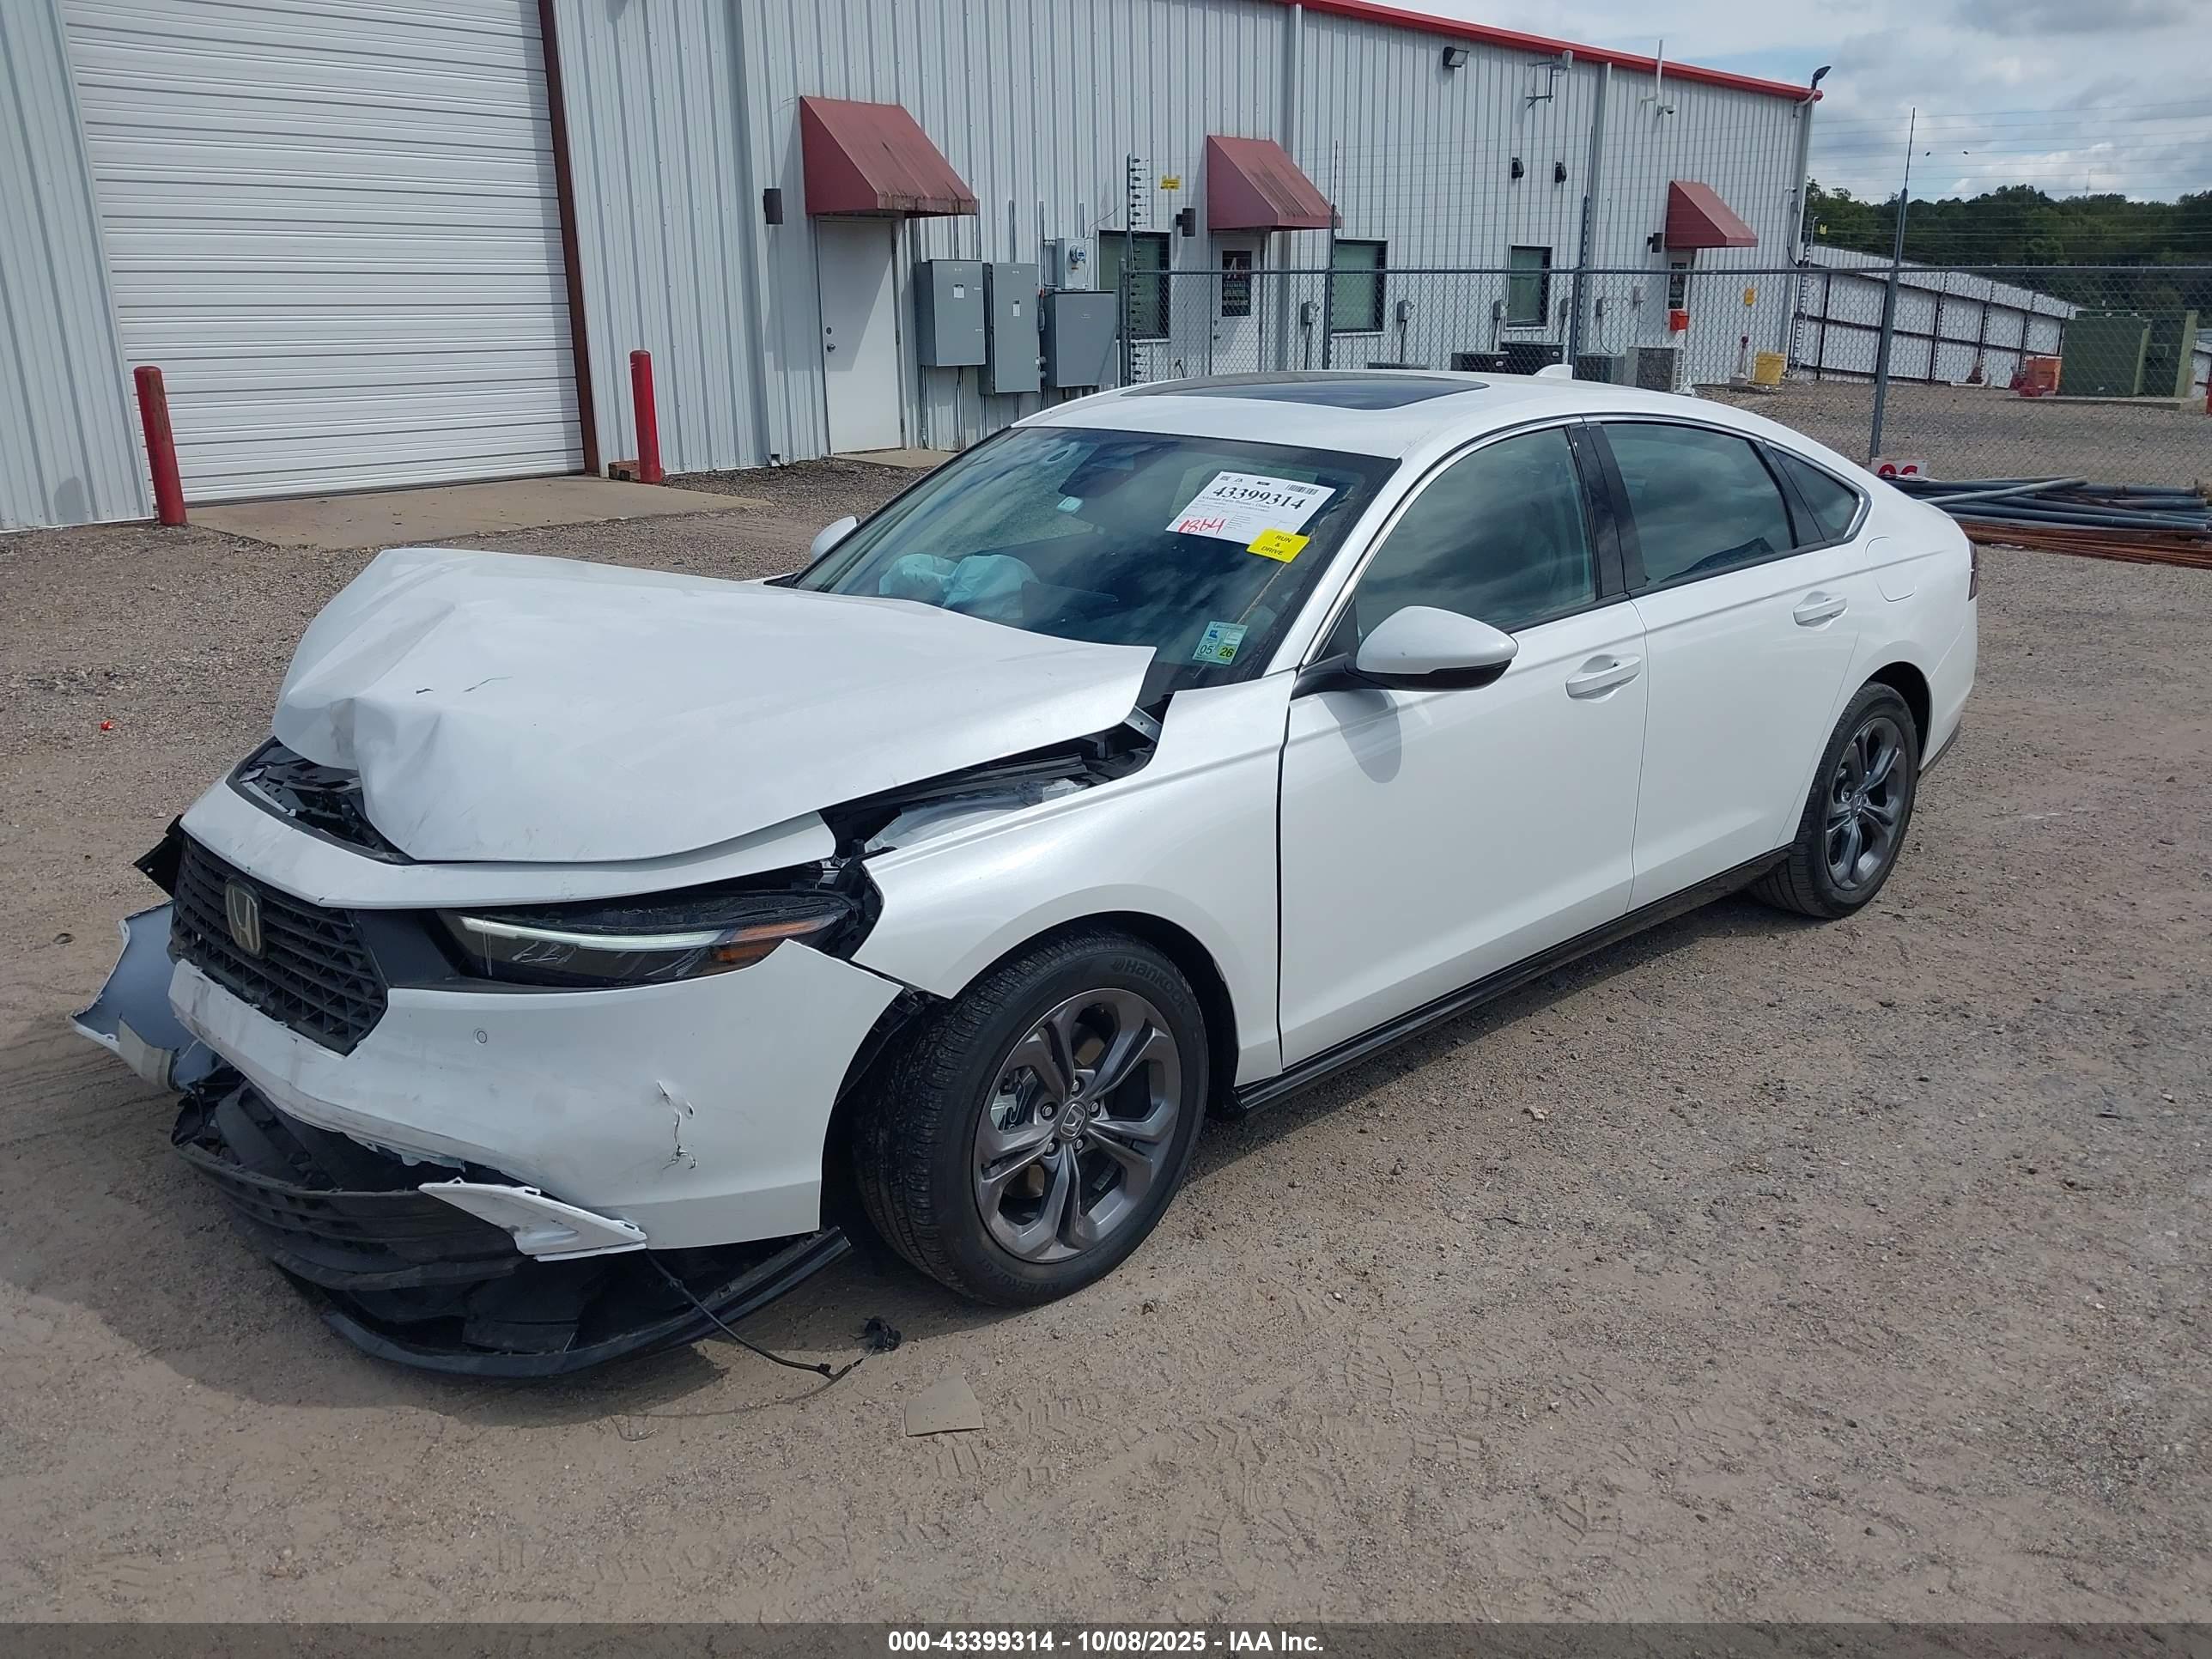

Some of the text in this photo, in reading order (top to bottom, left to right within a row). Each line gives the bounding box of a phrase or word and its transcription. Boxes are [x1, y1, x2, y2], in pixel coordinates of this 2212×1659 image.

[1212, 486, 1307, 510] 43399314
[1274, 534, 1292, 543] RUN
[1261, 545, 1285, 556] DRIVE
[1200, 644, 1214, 654] 05
[1218, 647, 1235, 658] 26
